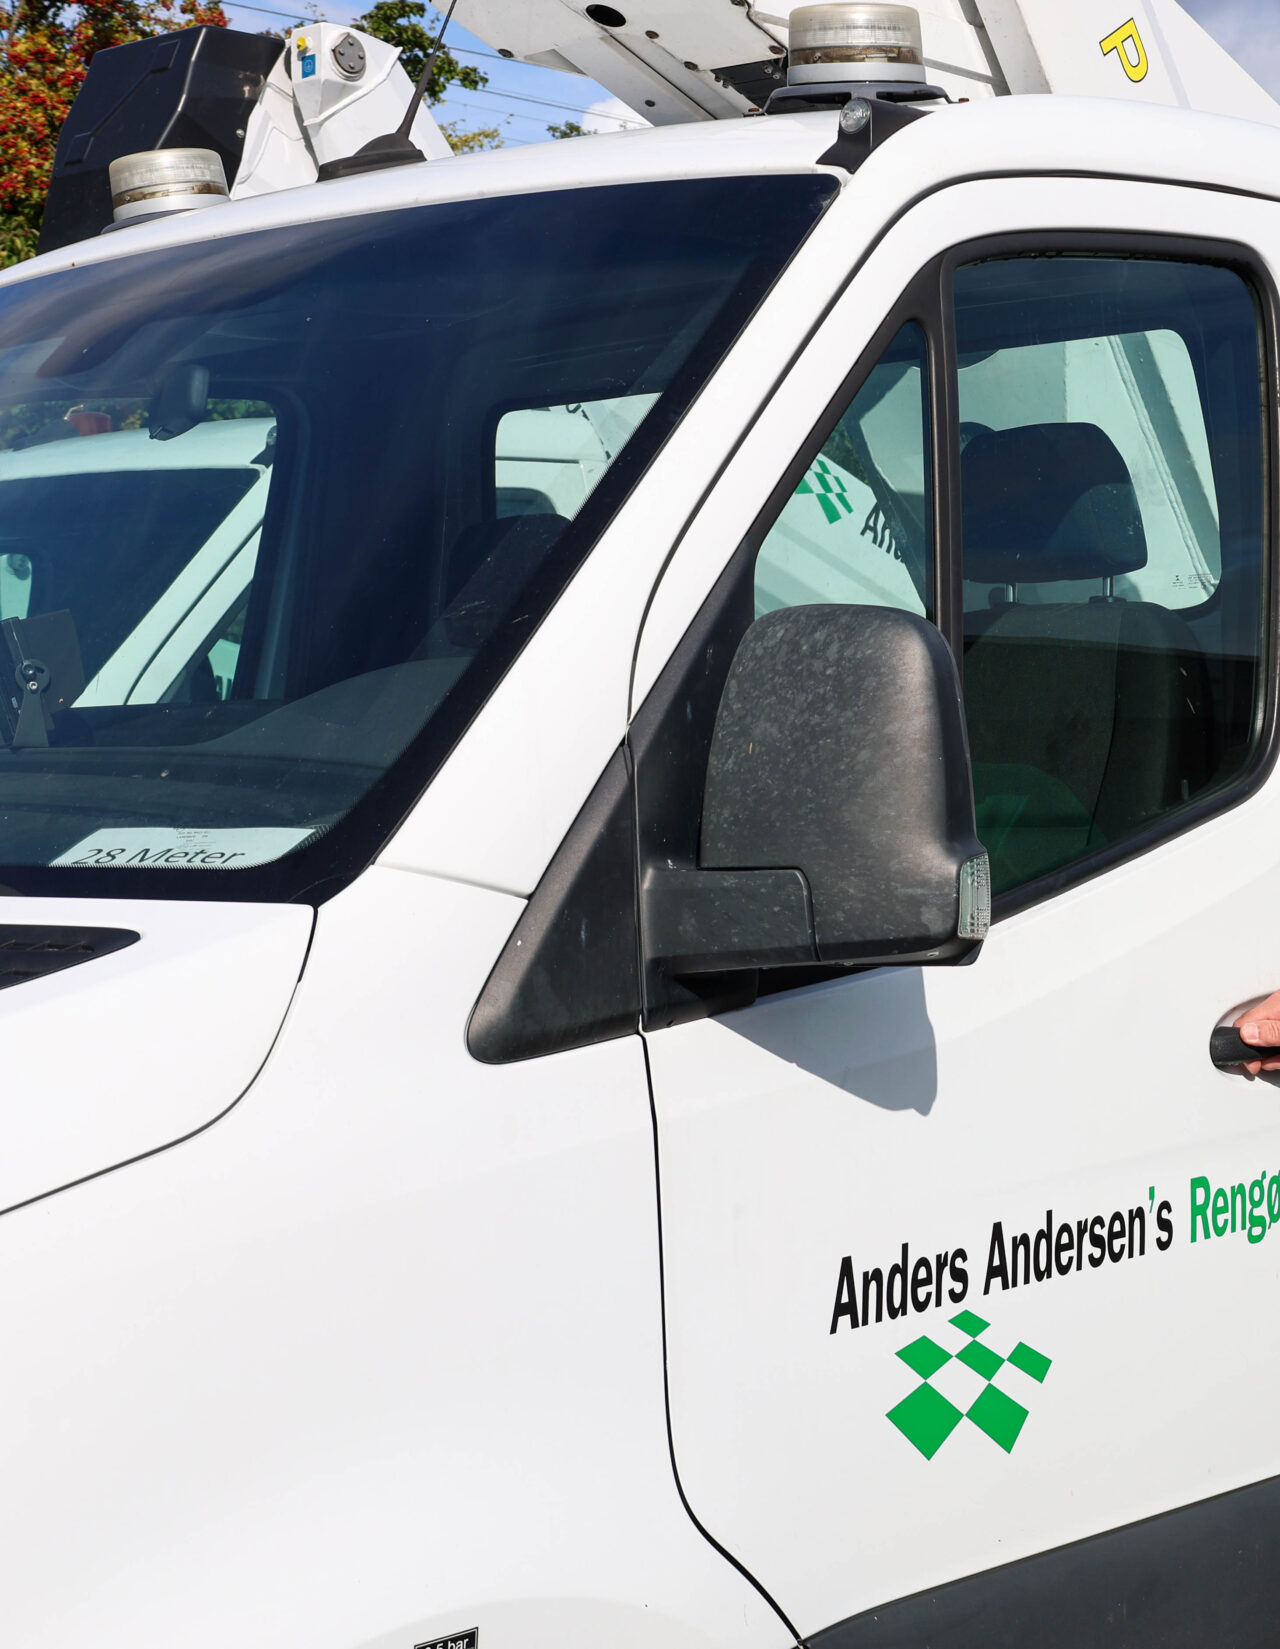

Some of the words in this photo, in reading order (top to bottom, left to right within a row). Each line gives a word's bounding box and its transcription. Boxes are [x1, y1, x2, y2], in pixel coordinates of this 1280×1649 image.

[1099, 17, 1149, 83] P
[72, 848, 126, 865] 28
[126, 848, 245, 865] Meter
[829, 1243, 969, 1335] Anders
[983, 1186, 1174, 1297] Andersen's
[447, 1638, 469, 1649] bar
